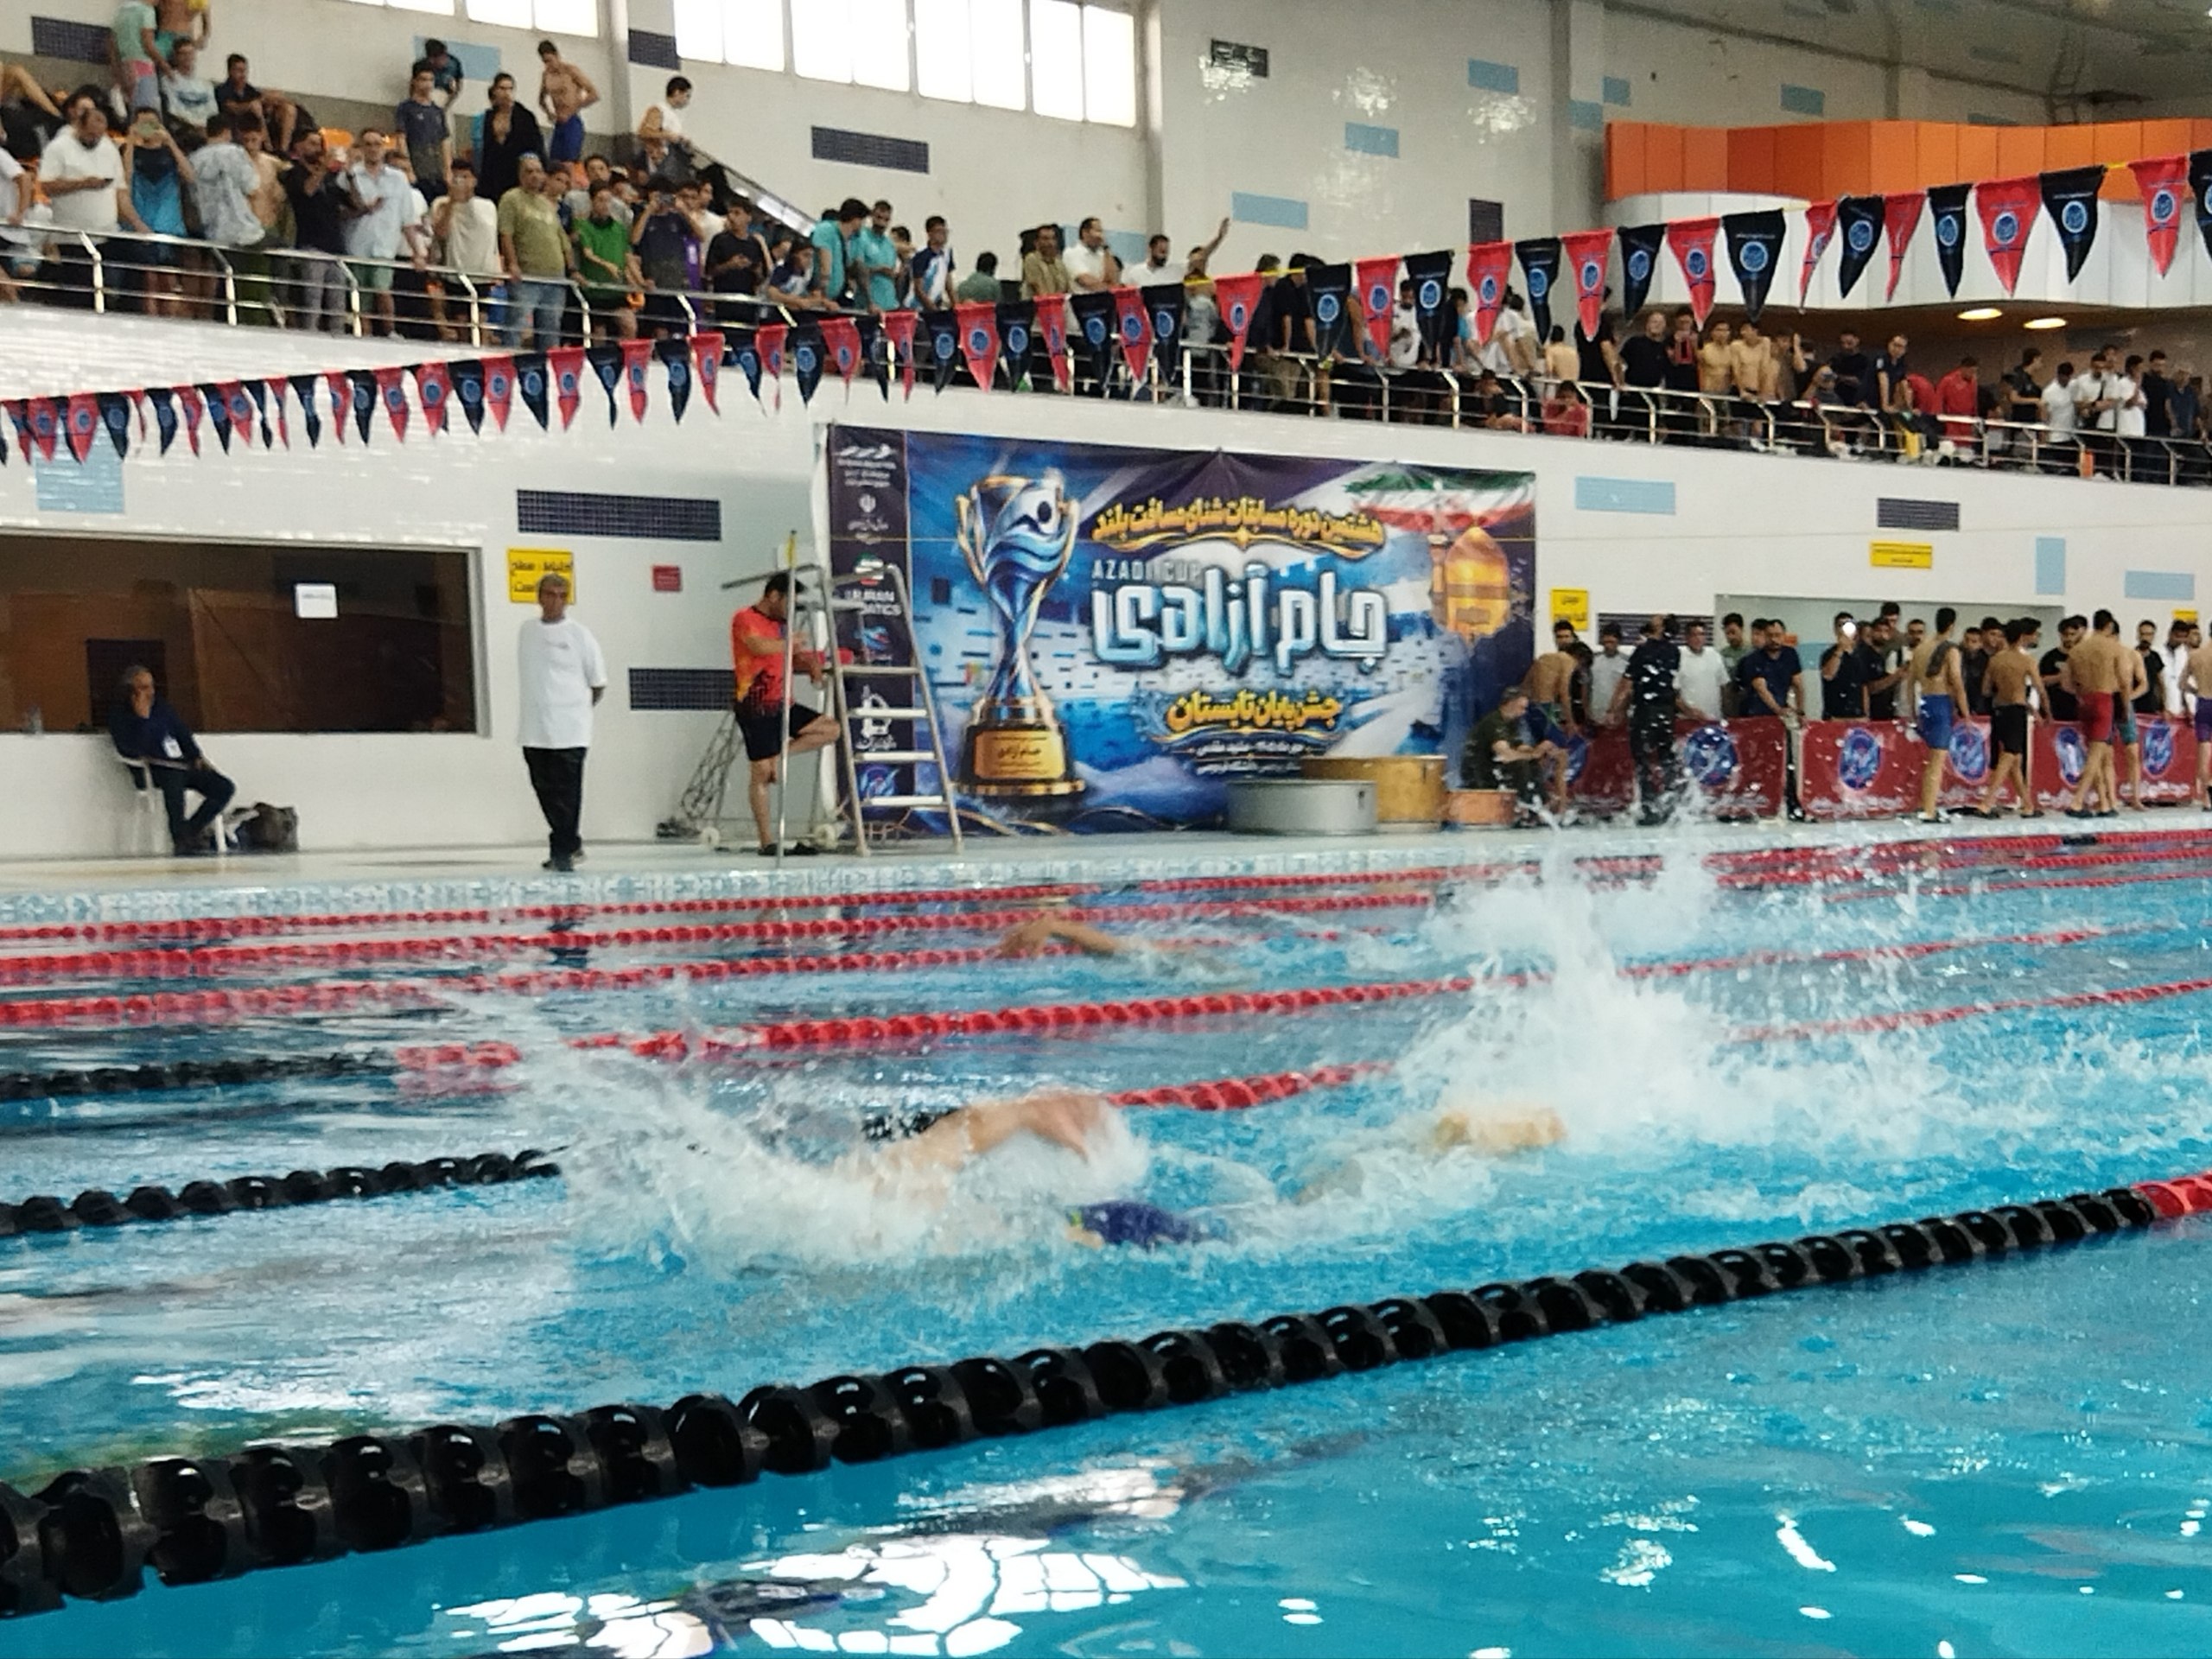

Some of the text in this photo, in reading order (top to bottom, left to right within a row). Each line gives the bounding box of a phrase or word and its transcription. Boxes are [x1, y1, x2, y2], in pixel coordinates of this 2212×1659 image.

[1224, 496, 1287, 533] مسابقات
[1090, 558, 1203, 582] AZADI CUP
[1090, 563, 1268, 672] آزادی
[1276, 570, 1388, 677] جام
[1166, 689, 1253, 731] تابستان
[1253, 690, 1297, 732] پایان
